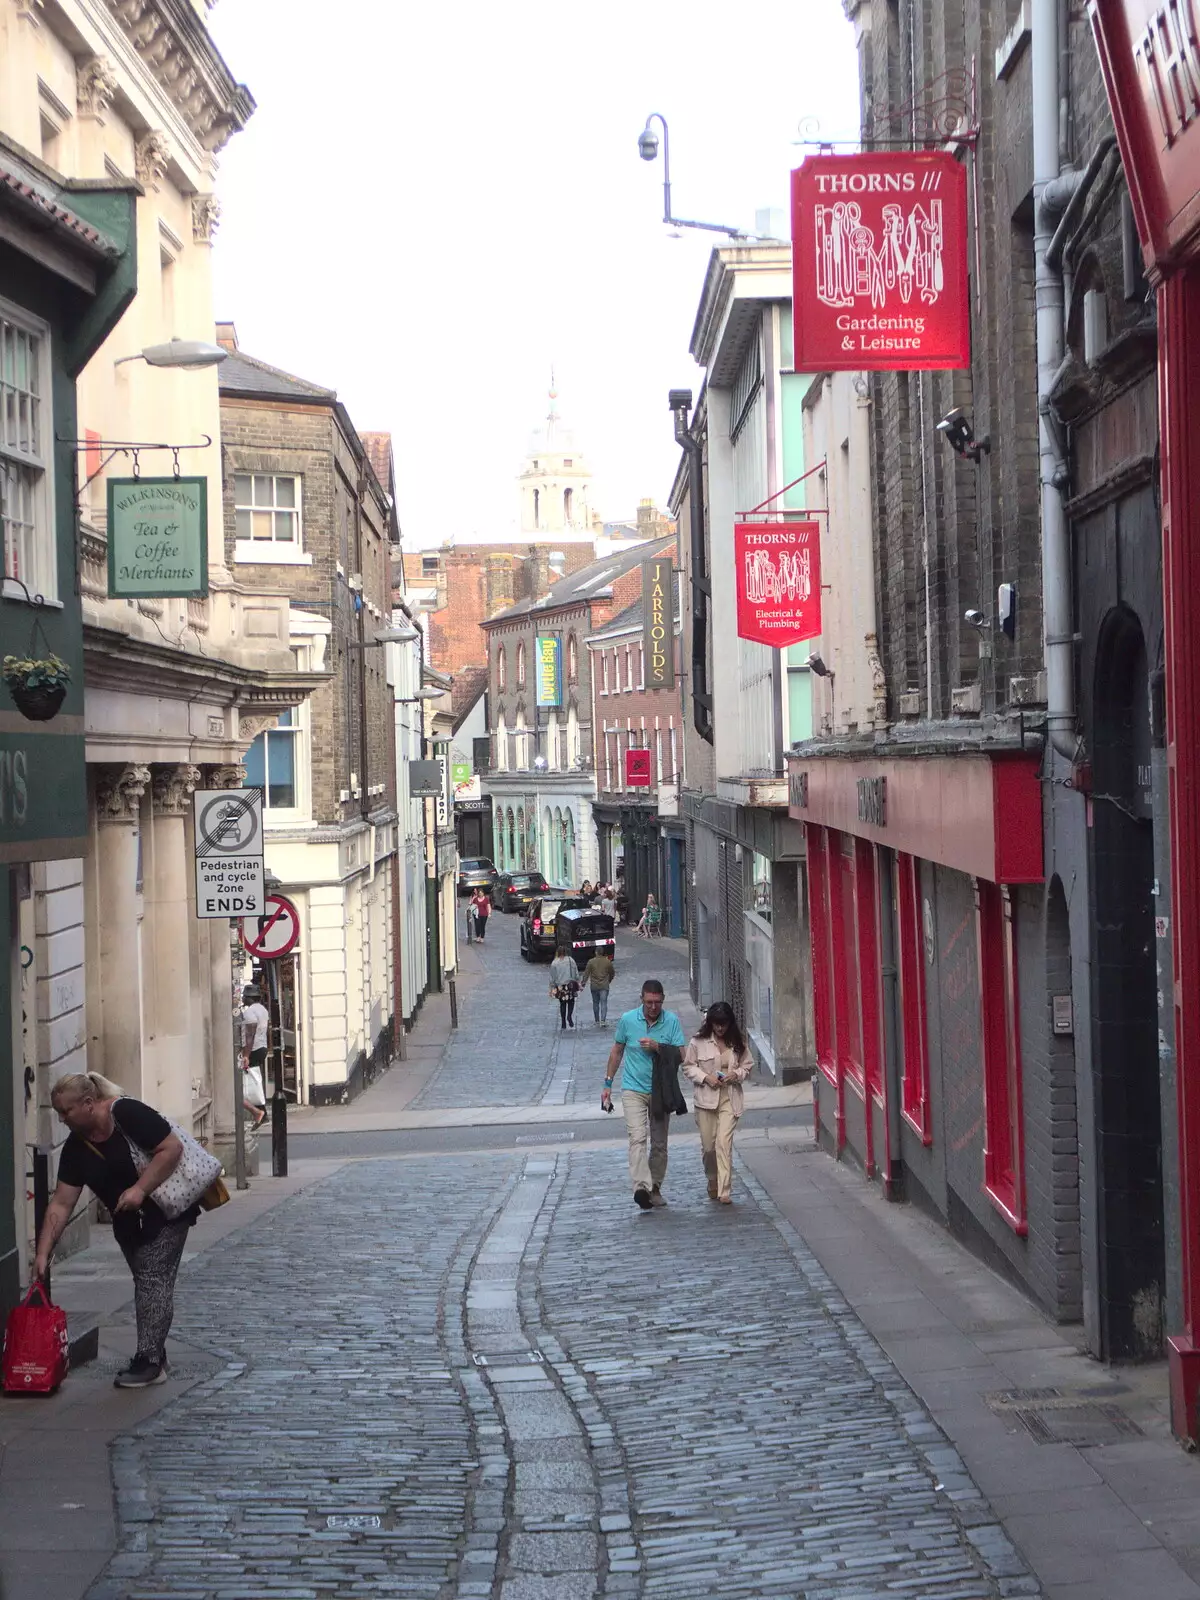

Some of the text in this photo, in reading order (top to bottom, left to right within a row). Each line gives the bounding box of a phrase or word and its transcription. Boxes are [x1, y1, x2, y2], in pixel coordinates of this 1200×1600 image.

[814, 172, 916, 193] THORNS
[836, 314, 925, 333] Gardening
[841, 335, 922, 351] & Leisure
[116, 487, 198, 512] WILKINSON'S
[134, 522, 180, 536] Tea &
[745, 533, 796, 545] THORNS
[135, 541, 180, 562] Coffee
[119, 564, 195, 581] Merchants
[756, 609, 794, 619] Electrical
[651, 564, 666, 682] JARROLDS
[759, 619, 801, 630] Plumbing
[464, 802, 484, 810] SCOTT
[200, 860, 260, 871] Pedestrian
[204, 871, 257, 883] and cycle
[217, 884, 244, 893] Zone
[206, 898, 256, 912] ENDS
